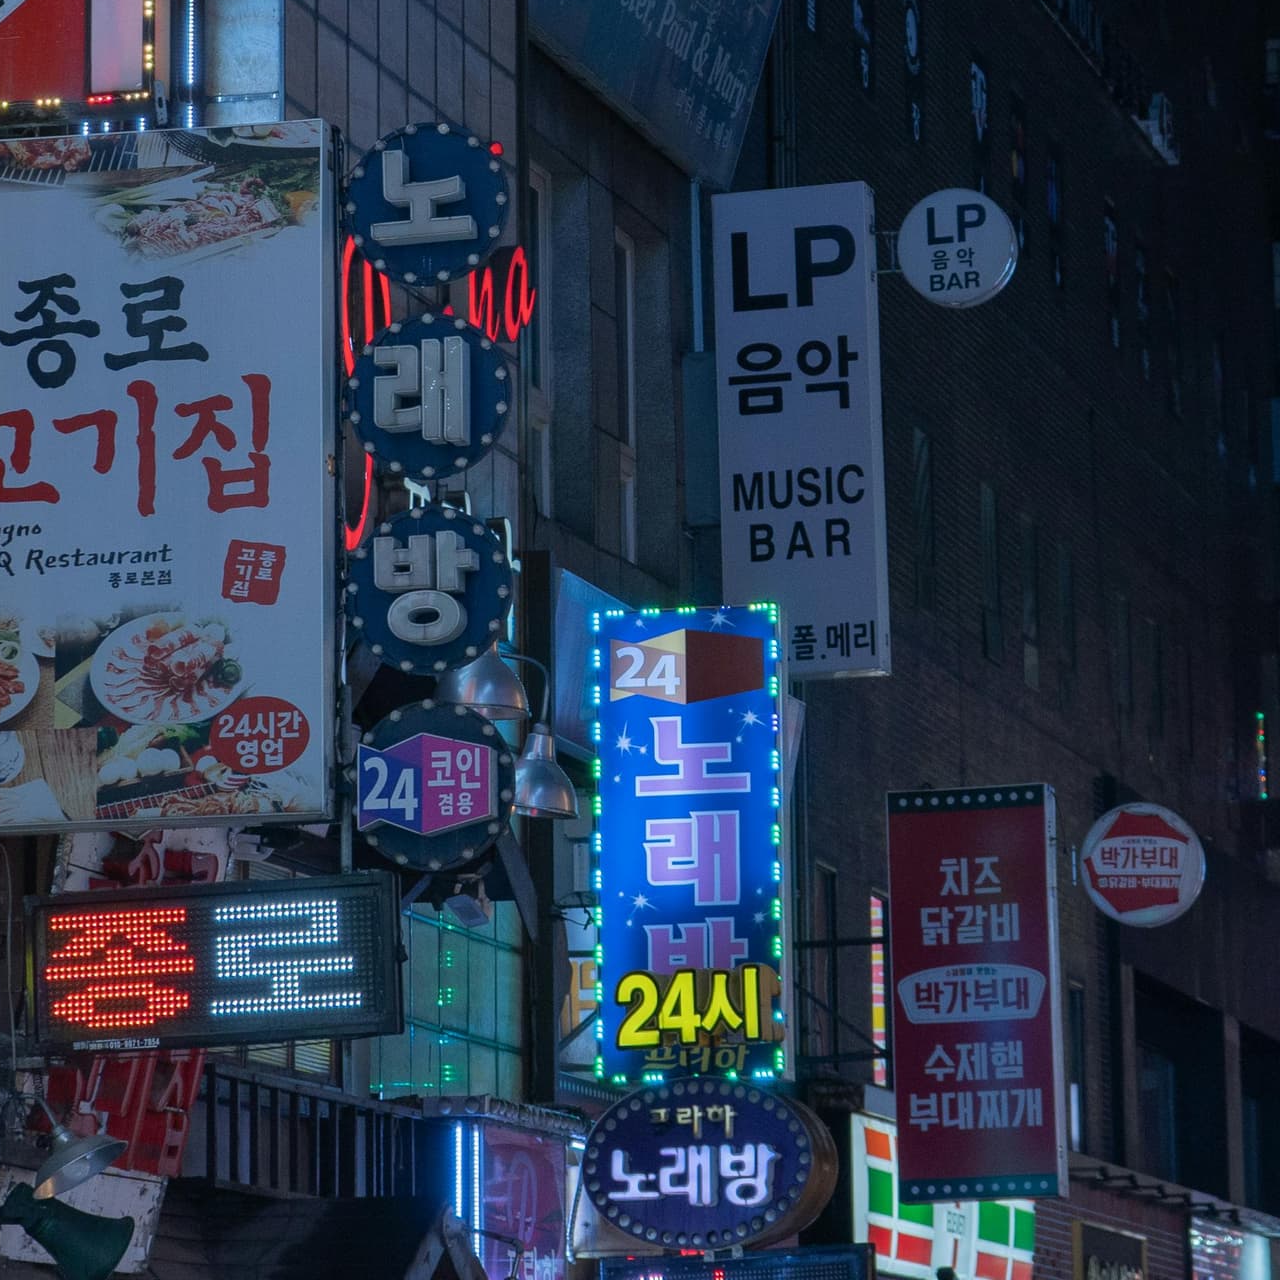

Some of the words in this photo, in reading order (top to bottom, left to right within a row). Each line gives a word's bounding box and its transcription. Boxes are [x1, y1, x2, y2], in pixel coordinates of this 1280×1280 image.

[925, 203, 987, 244] LP
[730, 224, 856, 313] LP
[929, 269, 981, 292] BAR
[930, 247, 975, 272] 음악
[728, 335, 858, 416] 음악
[370, 149, 481, 646] 노래방
[732, 464, 865, 513] MUSIC
[24, 544, 174, 575] Restaurant
[749, 518, 852, 563] BAR
[108, 571, 173, 589] 종로본점
[614, 646, 681, 695] 24
[217, 710, 303, 739] 24시간
[234, 738, 284, 769] 영업
[427, 748, 481, 789] 코인
[363, 756, 418, 821] 24
[939, 856, 1001, 897] 치즈
[1100, 846, 1178, 869] 박가부대
[920, 903, 1021, 946] 닭갈비
[45, 899, 362, 1029] 종로
[616, 966, 760, 1048] 24시
[915, 977, 1030, 1015] 박가부대
[924, 1040, 1024, 1081] 수제햄
[909, 1089, 1043, 1132] 부대찌개
[608, 1143, 782, 1207] 노래방
